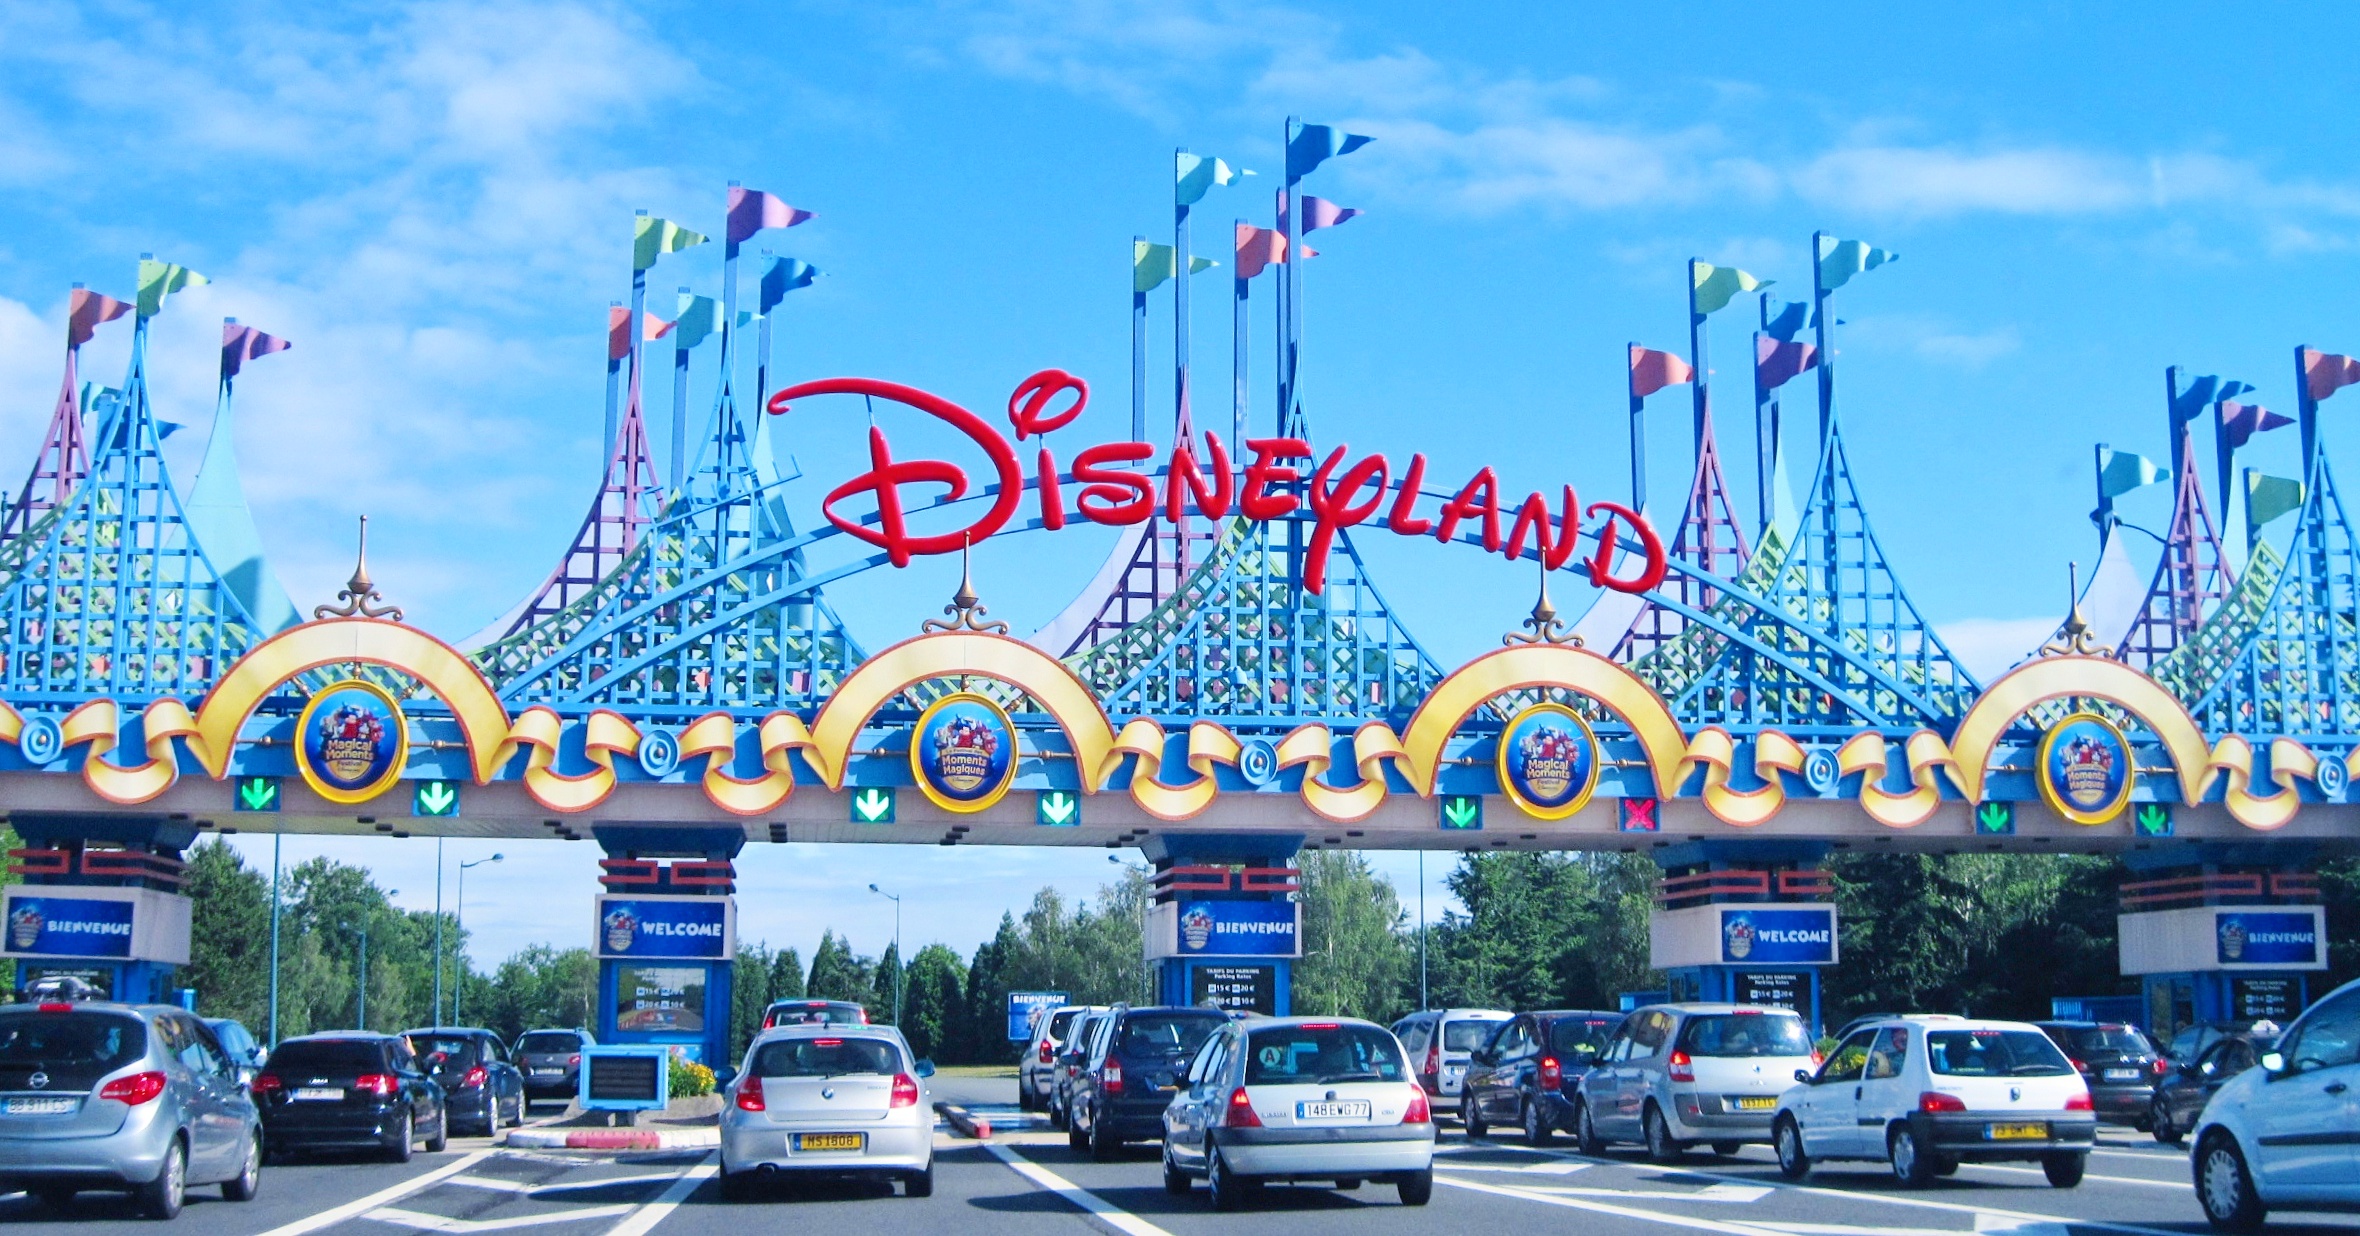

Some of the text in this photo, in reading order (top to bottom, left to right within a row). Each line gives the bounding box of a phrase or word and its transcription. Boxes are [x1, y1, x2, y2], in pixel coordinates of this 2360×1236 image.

[328, 739, 372, 751] Magical
[326, 750, 374, 760] Moments
[943, 756, 987, 767] Moments
[1528, 759, 1569, 770] Magical
[943, 765, 986, 776] Magiques
[1526, 769, 1571, 779] Moments
[47, 920, 131, 936] BIENVENUE
[641, 921, 722, 937] WELCOME
[1216, 921, 1294, 935] BIENVENUE
[1758, 929, 1829, 943] WELCOME
[2248, 931, 2314, 944] BIENVENUE
[1013, 995, 1065, 1004] BIENVENUE
